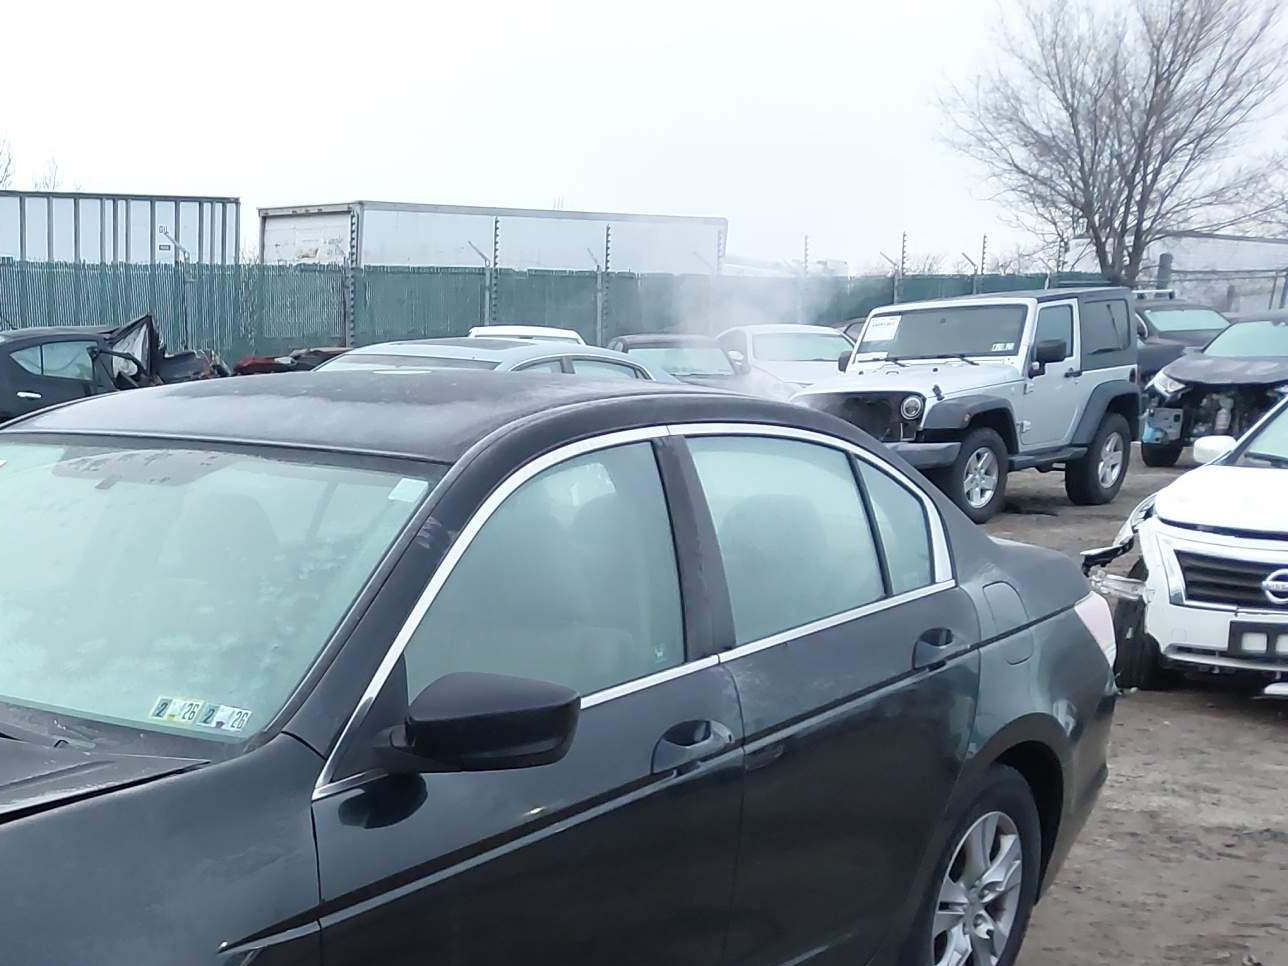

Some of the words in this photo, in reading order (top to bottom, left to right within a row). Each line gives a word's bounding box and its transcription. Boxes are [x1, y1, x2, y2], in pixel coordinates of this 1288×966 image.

[156, 702, 169, 718] 2
[181, 703, 200, 720] 26
[230, 711, 249, 729] 26
